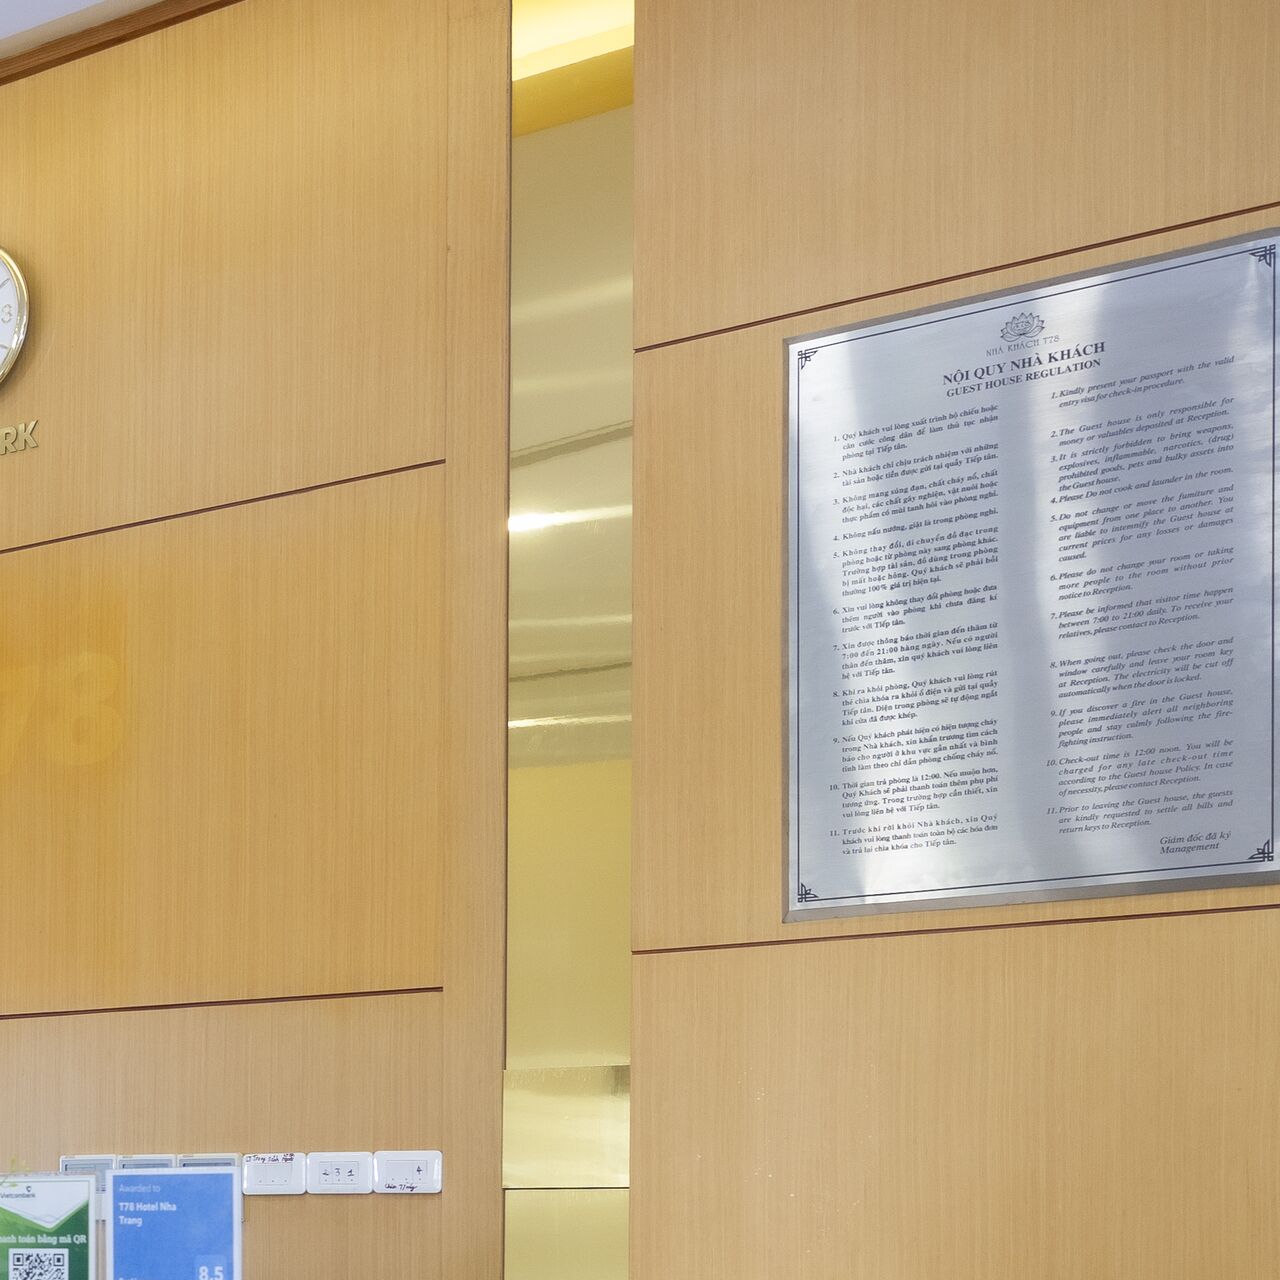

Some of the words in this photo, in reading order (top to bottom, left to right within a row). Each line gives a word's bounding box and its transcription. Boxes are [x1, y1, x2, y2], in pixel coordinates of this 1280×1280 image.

[1, 303, 13, 324] 3
[943, 368, 969, 385] NỘI
[973, 362, 1006, 379] QUY
[1010, 352, 1042, 371] NHÀ
[1047, 341, 1104, 363] KHÁCH
[1051, 391, 1058, 399] 1.
[1058, 386, 1084, 397] Kindly
[1086, 380, 1116, 393] present
[1118, 376, 1137, 387] your
[1138, 368, 1173, 383] passport
[1176, 364, 1194, 373] with
[1197, 361, 1211, 369] the
[1214, 355, 1234, 365] valid
[946, 382, 982, 397] GUEST
[985, 374, 1022, 389] HOUSE
[1025, 358, 1100, 381] REGULATION
[1058, 399, 1079, 407] entry
[1094, 392, 1108, 402] for
[1108, 385, 1142, 398] check-in
[1142, 378, 1184, 392] procedure.
[1050, 430, 1057, 438] 2.
[1059, 428, 1074, 436] The
[1078, 422, 1102, 432] Guest
[1106, 417, 1131, 427] house
[1146, 409, 1165, 419] only
[1168, 400, 1216, 415] responsible
[1219, 397, 1234, 407] for
[1058, 437, 1084, 446] money
[1097, 427, 1133, 438] valuables
[1135, 418, 1173, 432] deposited
[1186, 409, 1229, 422] Reception.
[1050, 496, 1057, 504] 4.
[1058, 493, 1083, 502] Please
[1084, 490, 1097, 498] Do
[1098, 487, 1112, 495] not
[1113, 483, 1132, 493] cook
[1134, 480, 1150, 489] and
[1151, 475, 1183, 486] launder
[1194, 470, 1208, 478] the
[1209, 467, 1233, 476] room.
[842, 531, 866, 540] Không
[932, 516, 953, 524] trong
[954, 512, 978, 522] phòng
[1058, 591, 1082, 600] notice
[1091, 584, 1132, 595] Reception.
[1058, 610, 1083, 618] Please
[1097, 600, 1133, 613] informed
[1135, 599, 1152, 607] that
[1155, 595, 1180, 603] visitor
[1182, 592, 1200, 600] time
[1203, 587, 1233, 597] happen
[1058, 619, 1089, 628] between
[1092, 615, 1109, 623] 7:00
[1122, 610, 1144, 619] 21:00
[1171, 604, 1181, 612] To
[1183, 600, 1213, 610] receive
[1214, 597, 1234, 607] your
[1092, 625, 1117, 636] please
[1118, 620, 1147, 630] contact
[1157, 613, 1199, 624] Reception.
[1058, 718, 1084, 728] please
[1087, 710, 1138, 722] immediately
[1141, 707, 1162, 716] alert
[1166, 704, 1178, 713] all
[1182, 698, 1233, 710] neighboring
[1058, 754, 1099, 765] Check-out
[1102, 752, 1120, 760] time
[1134, 747, 1156, 756] 12:00
[1205, 739, 1220, 747] will
[1223, 738, 1233, 746] be
[1159, 842, 1219, 854] Management
[119, 1184, 151, 1193] Awarded
[152, 1185, 160, 1193] to
[119, 1202, 135, 1211] T78
[136, 1202, 158, 1211] Hotel
[160, 1202, 177, 1211] Nha
[119, 1216, 143, 1227] Trang
[73, 1235, 87, 1244] QR
